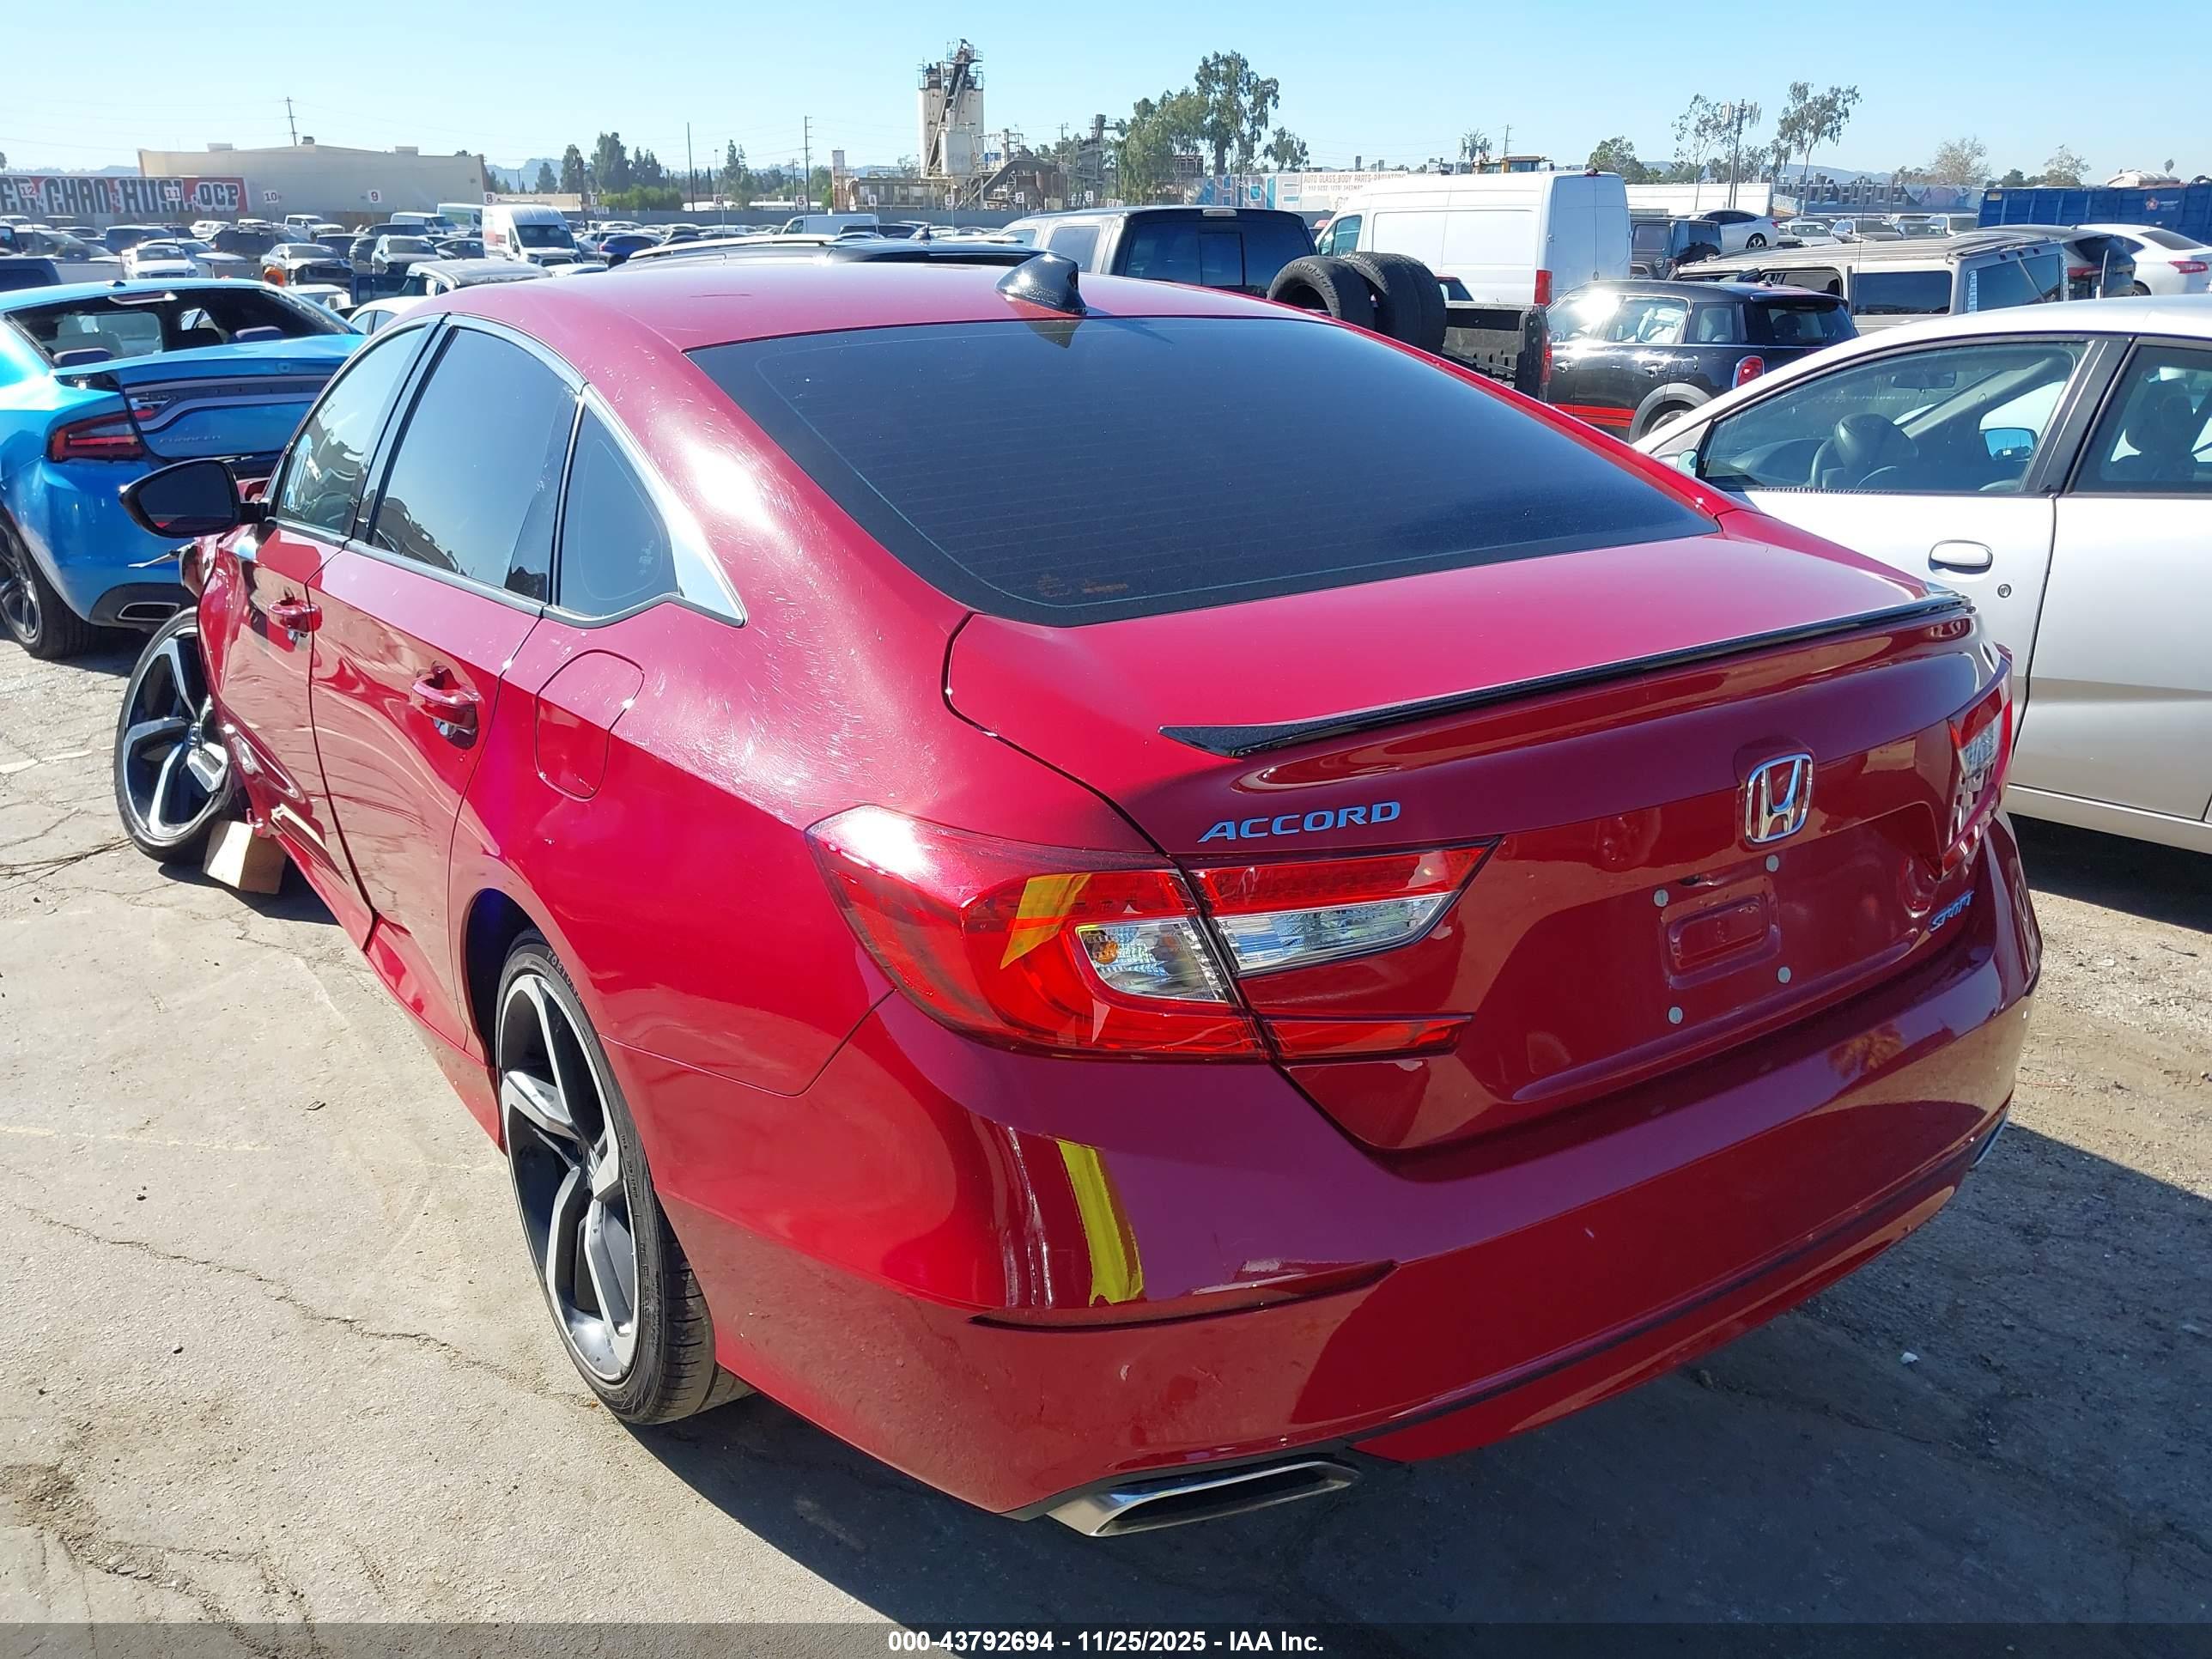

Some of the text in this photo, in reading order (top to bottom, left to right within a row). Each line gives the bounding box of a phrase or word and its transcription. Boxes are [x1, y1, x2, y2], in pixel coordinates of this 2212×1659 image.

[1304, 174, 1317, 184] AUTO
[20, 185, 35, 196] 12
[166, 190, 179, 199] 11
[198, 183, 239, 207] OCP
[264, 191, 277, 202] 10
[371, 191, 379, 202] 9
[486, 193, 494, 204] 8
[715, 196, 722, 205] 6
[798, 196, 805, 205] 5
[946, 195, 953, 204] 3
[1017, 193, 1023, 202] 2
[1196, 801, 1401, 843] ACCORD
